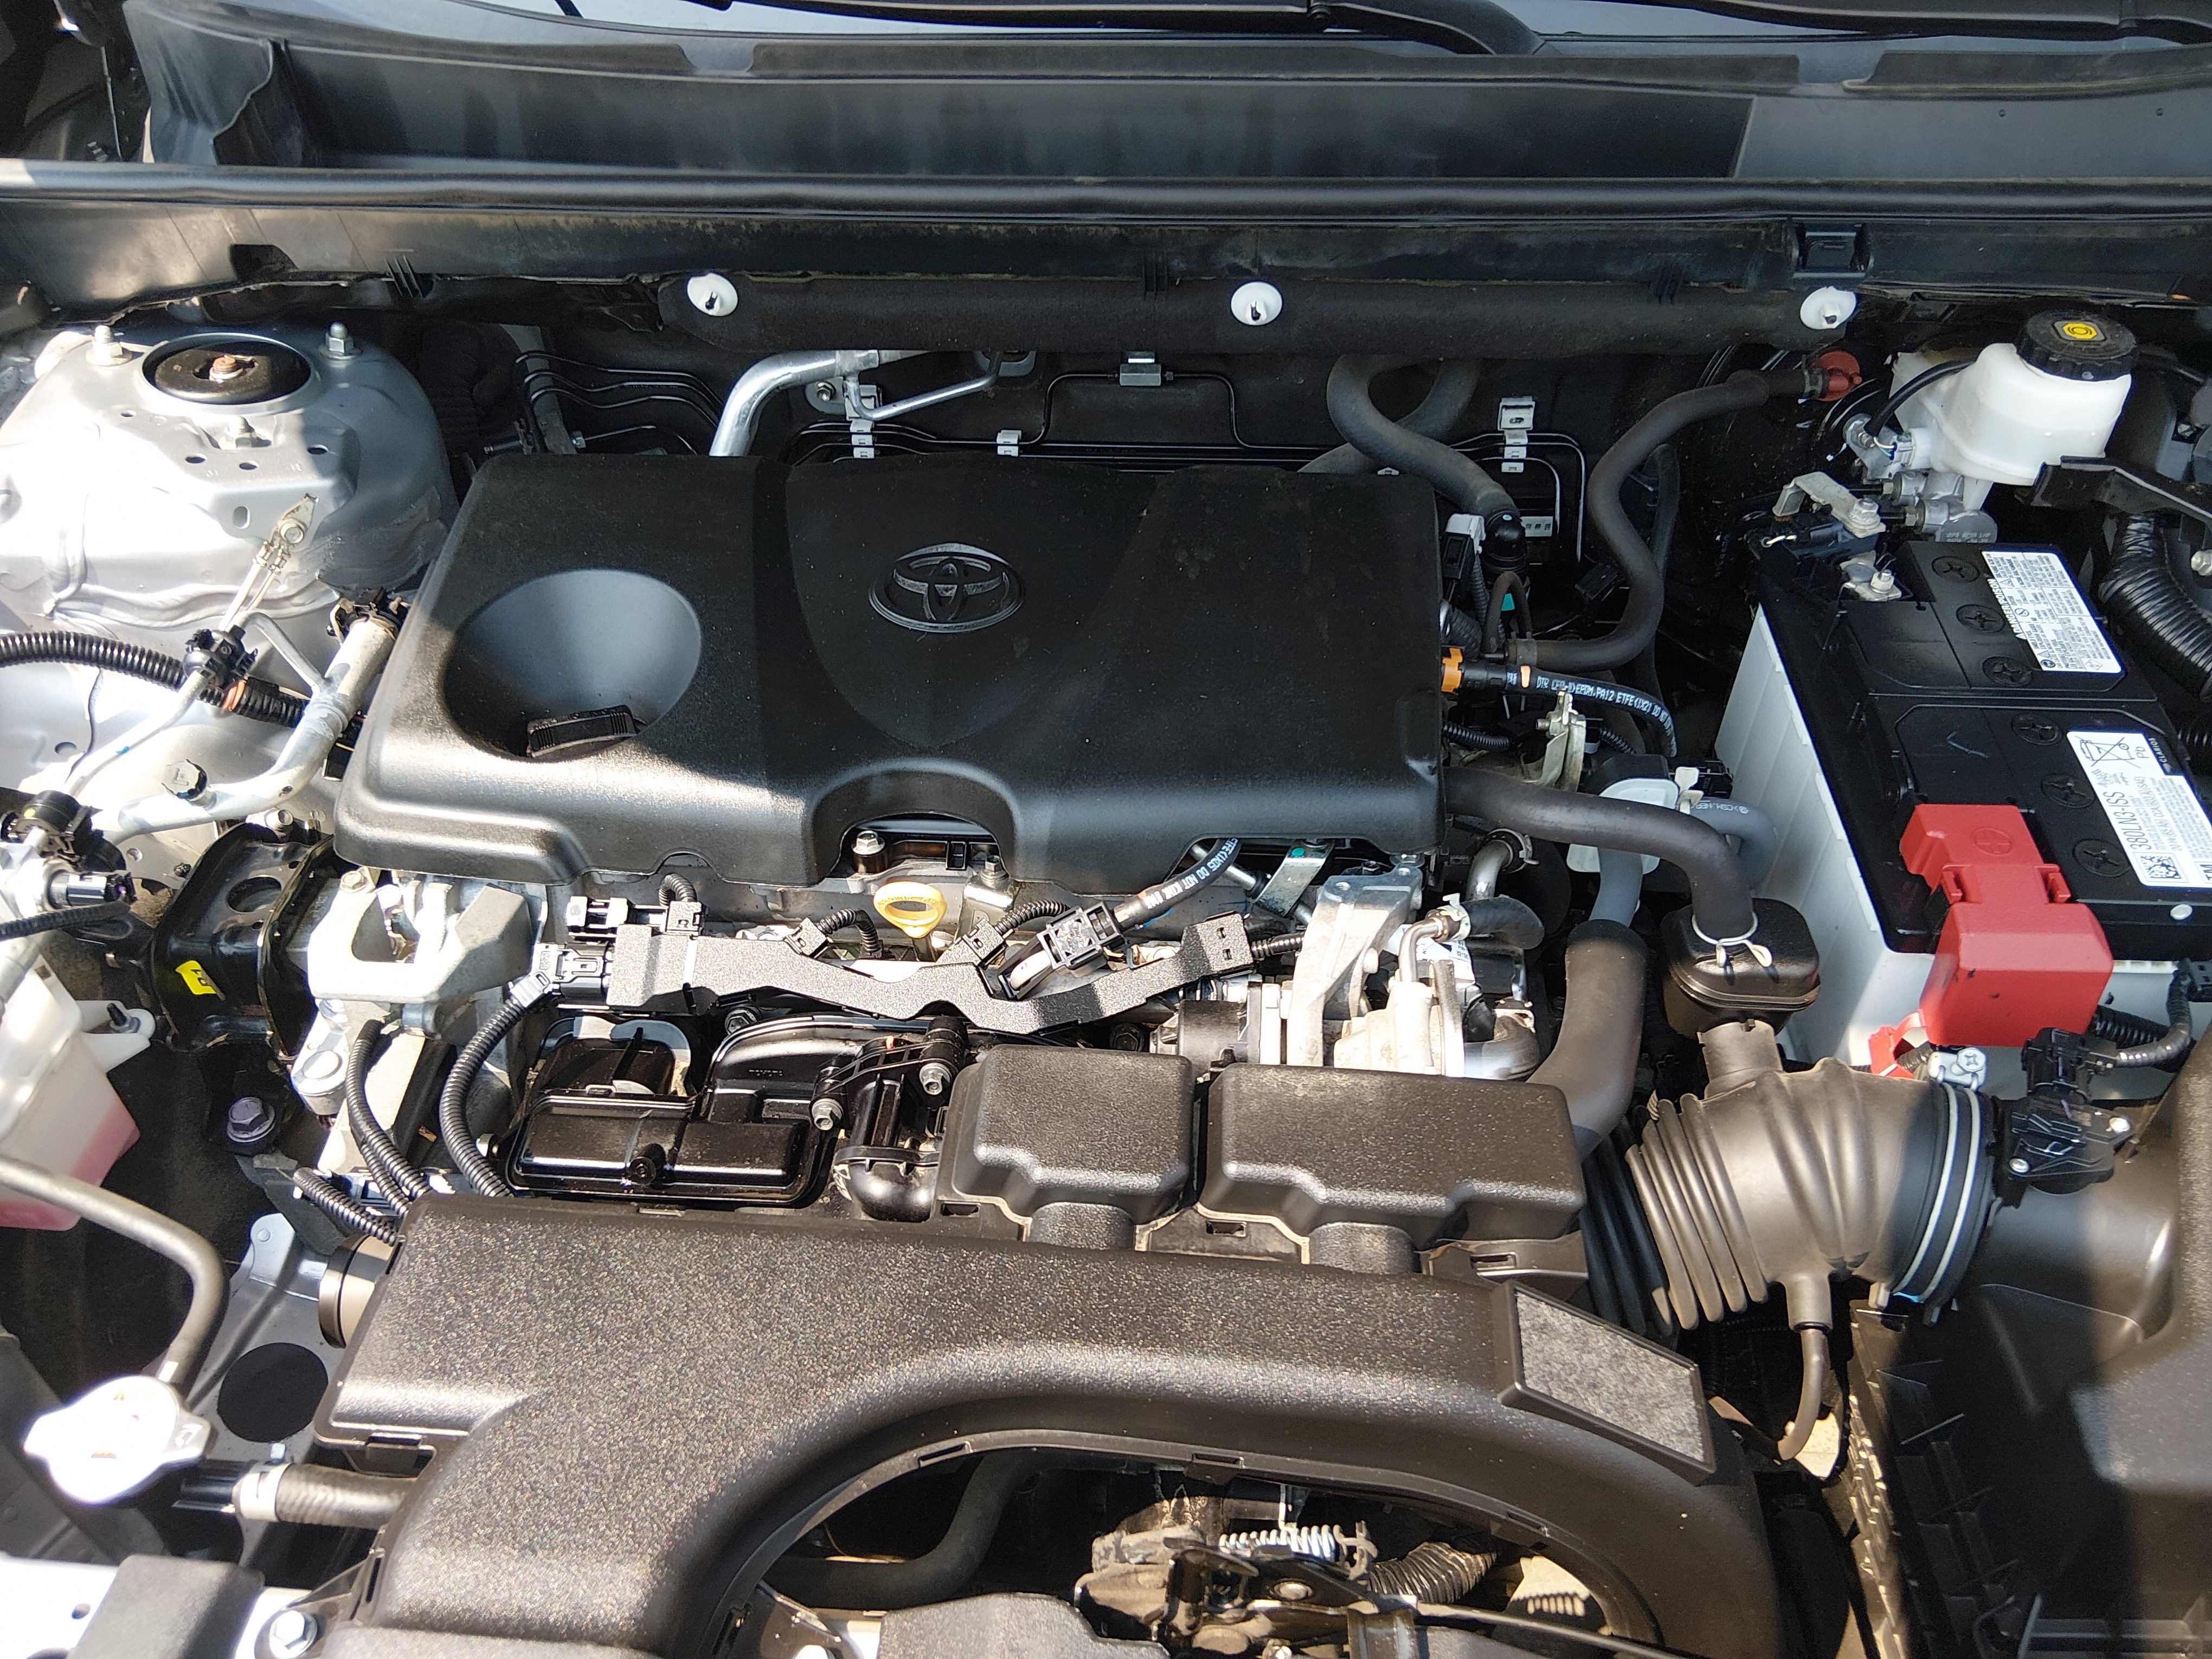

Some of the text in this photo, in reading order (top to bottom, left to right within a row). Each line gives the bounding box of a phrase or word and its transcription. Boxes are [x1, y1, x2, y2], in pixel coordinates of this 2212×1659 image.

[1986, 578, 2023, 632] DANGER/POISON
[2134, 746, 2148, 758] Pb
[2147, 737, 2168, 762] CLARIOS
[2102, 791, 2152, 850] 380LN3-ISS
[1181, 873, 1198, 889] NOT
